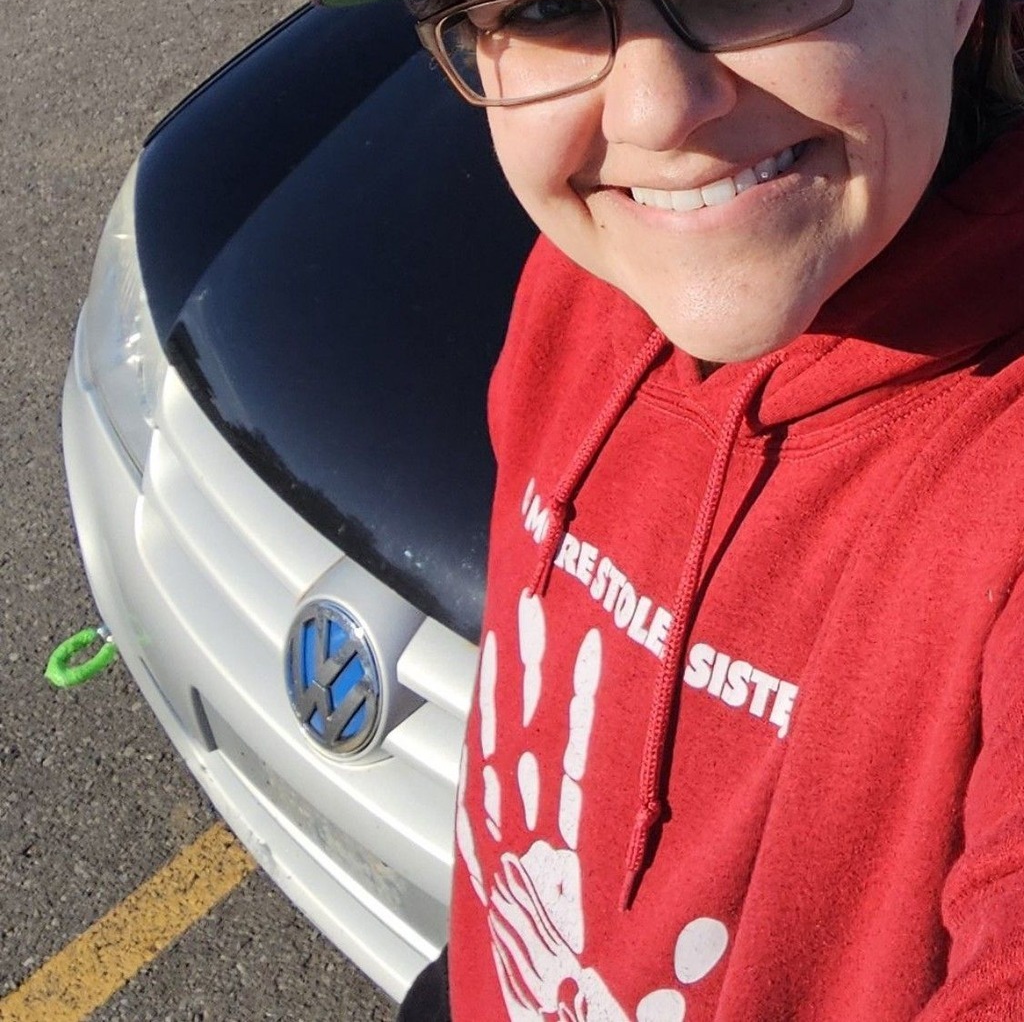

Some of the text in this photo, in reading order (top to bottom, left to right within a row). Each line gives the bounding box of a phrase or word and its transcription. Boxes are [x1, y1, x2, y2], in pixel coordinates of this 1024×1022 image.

[524, 494, 800, 740] MRE STOLE SISTE
